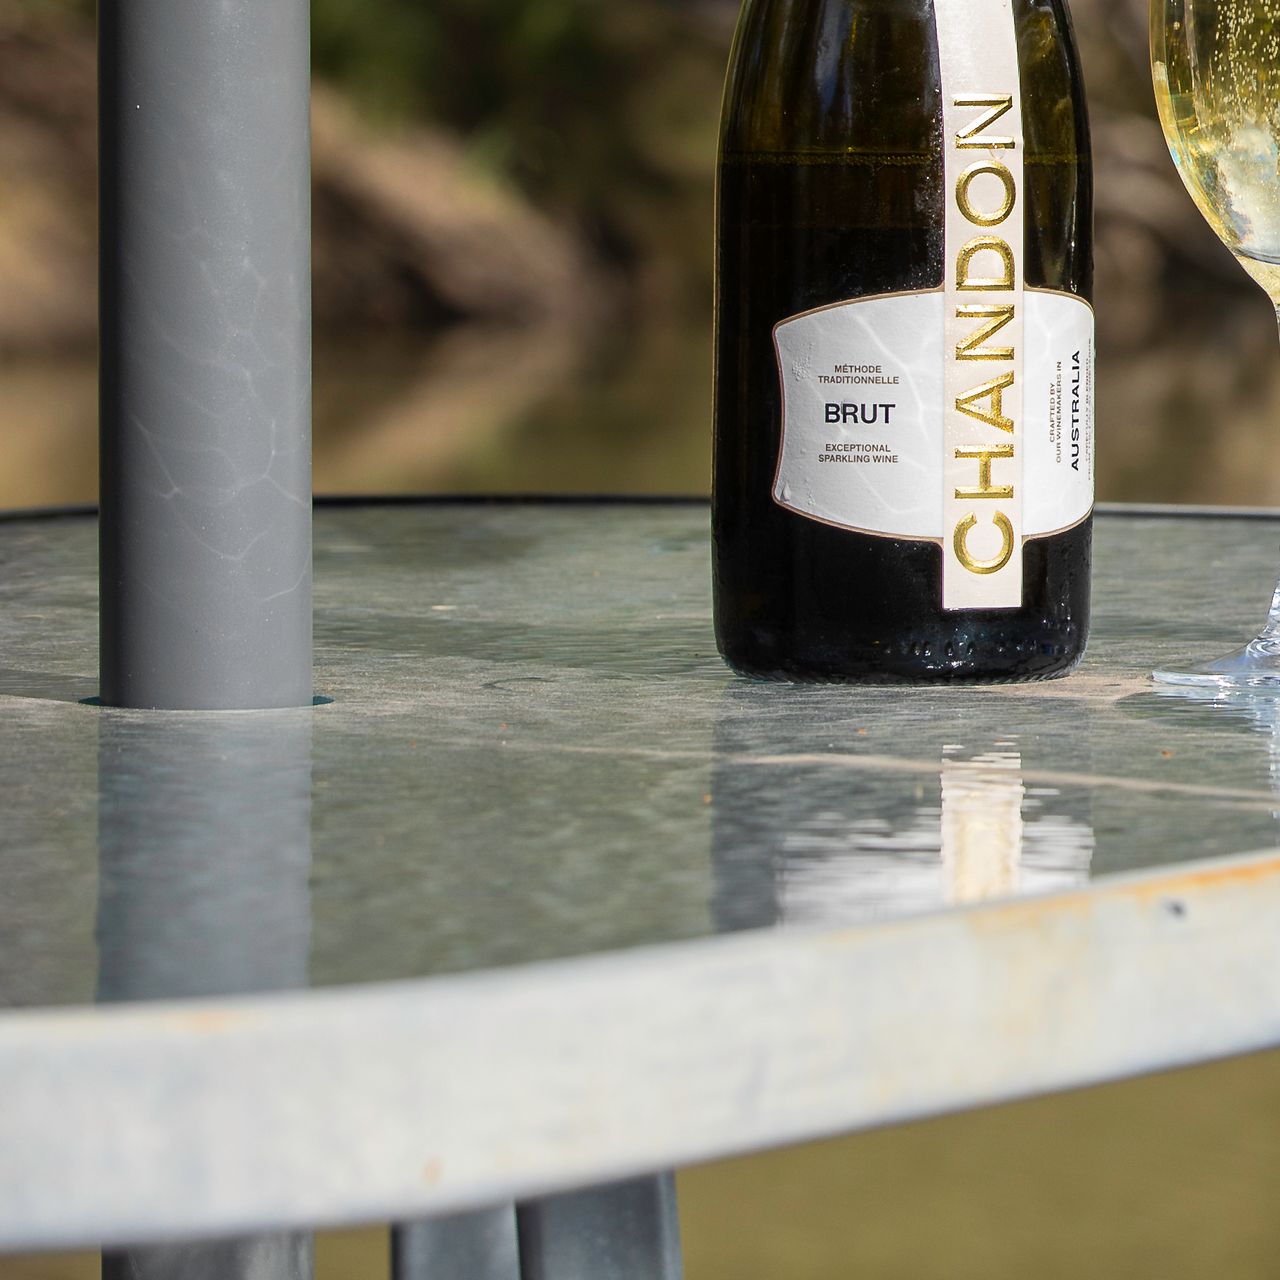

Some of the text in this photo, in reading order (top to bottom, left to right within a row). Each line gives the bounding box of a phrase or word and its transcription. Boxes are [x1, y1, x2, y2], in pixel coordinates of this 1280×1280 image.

[952, 92, 1016, 576] CHANDON
[834, 363, 882, 374] MÉTHODE
[1056, 360, 1062, 371] IN
[818, 375, 900, 385] TRADITIONNELLE
[1049, 382, 1055, 395] BY
[825, 403, 896, 424] BRUT
[1071, 350, 1080, 471] AUSTRALIA
[825, 443, 891, 453] EXCEPTIONAL
[818, 455, 899, 464] SPARKLING WINE
